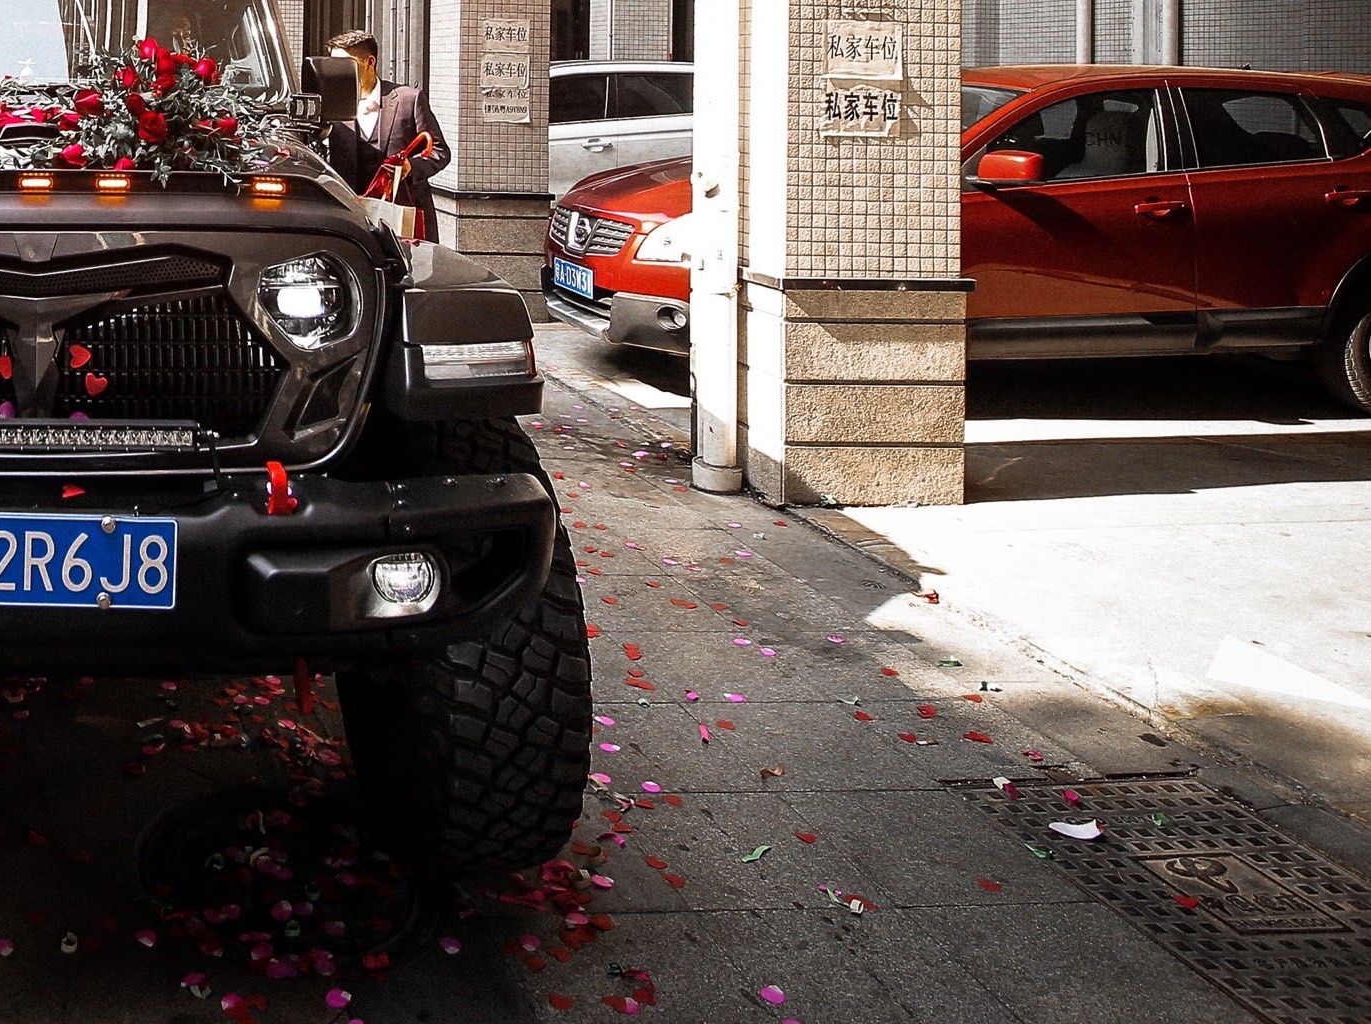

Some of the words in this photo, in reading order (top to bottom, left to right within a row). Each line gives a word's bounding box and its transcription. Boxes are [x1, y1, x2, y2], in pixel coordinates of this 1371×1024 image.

[484, 26, 527, 42] 私家车位
[827, 34, 897, 61] 私家车位
[484, 62, 527, 78] 私家车位
[824, 91, 898, 122] 私家车位
